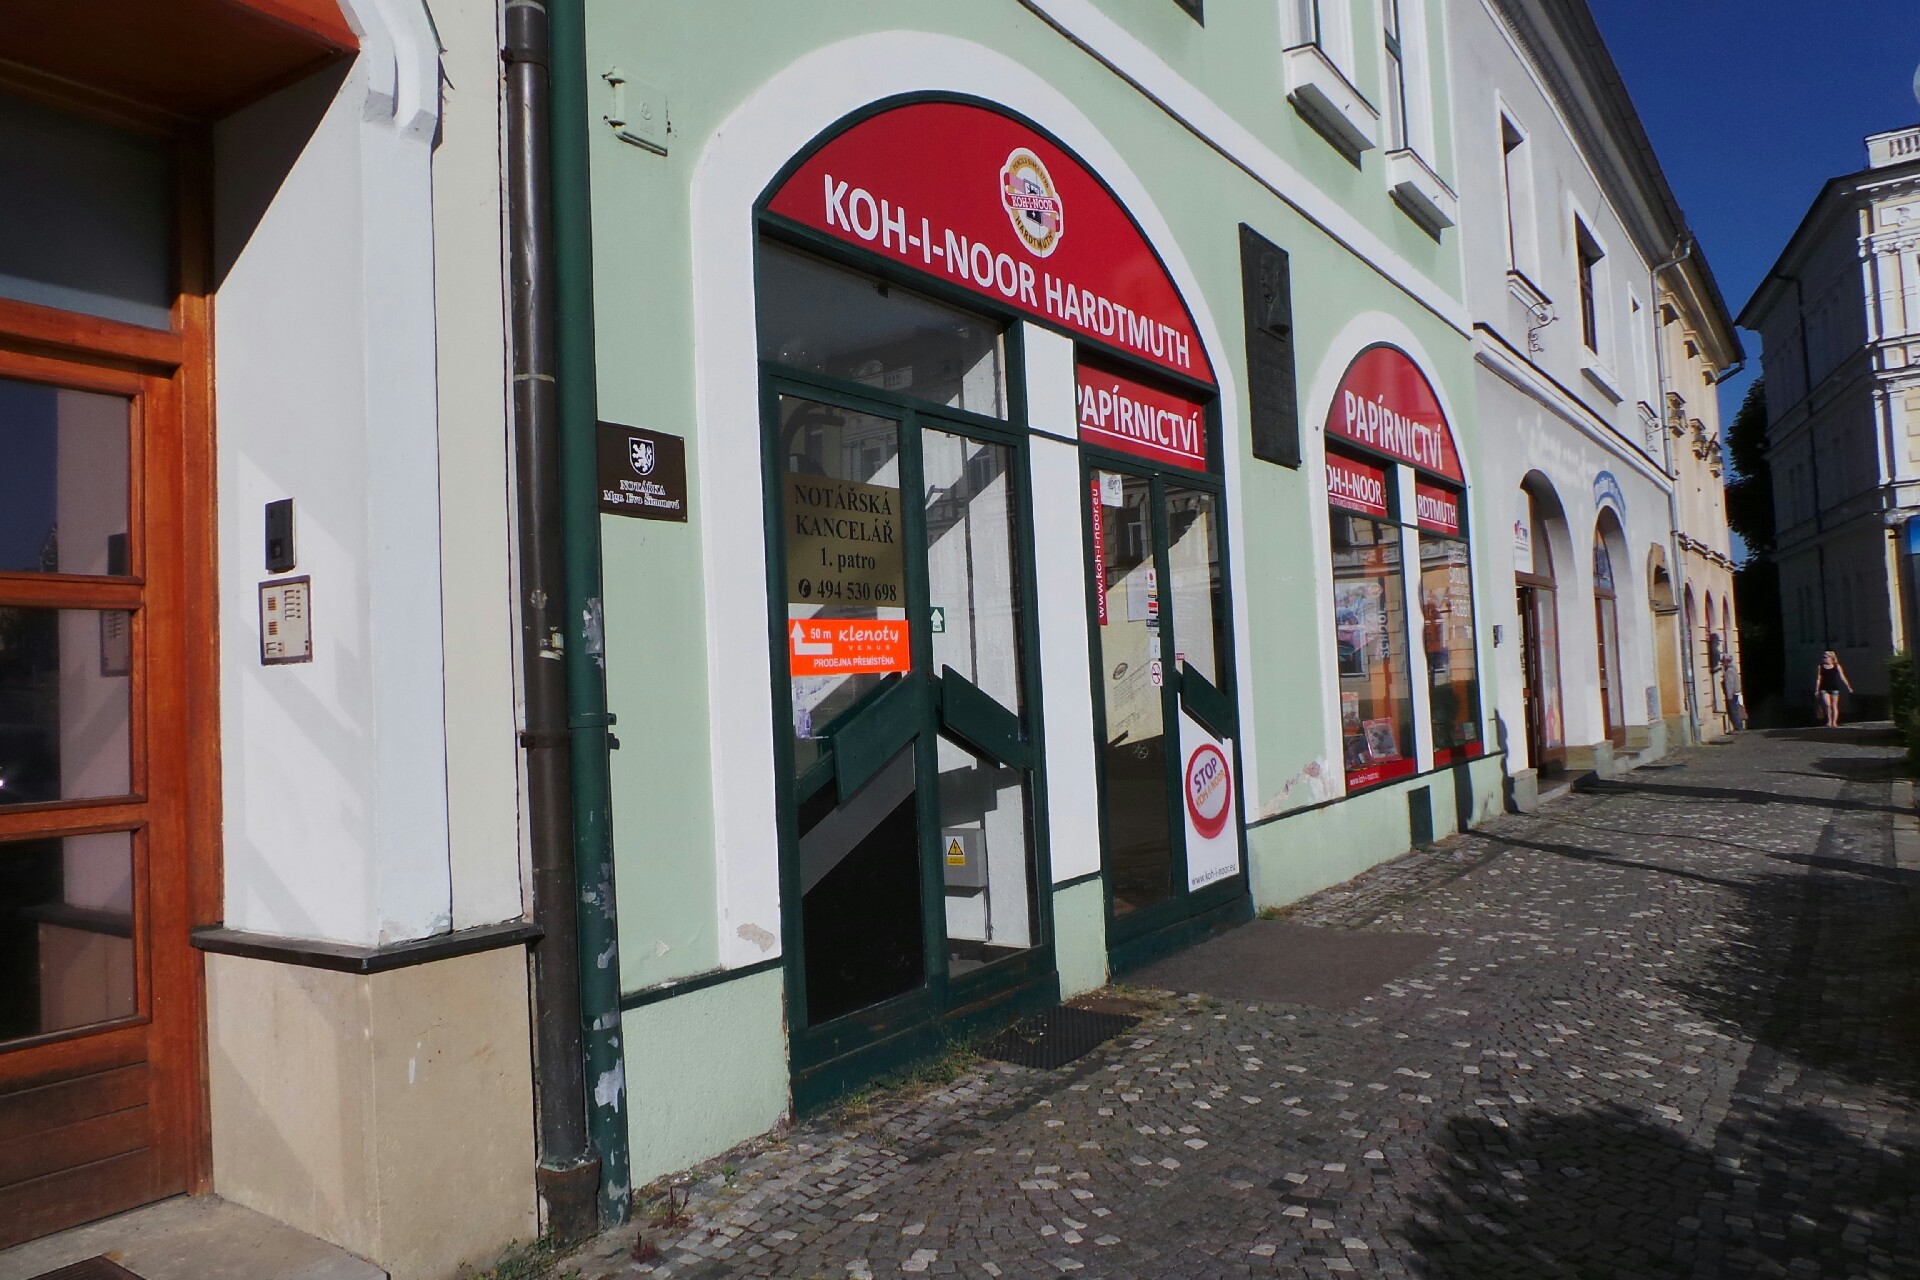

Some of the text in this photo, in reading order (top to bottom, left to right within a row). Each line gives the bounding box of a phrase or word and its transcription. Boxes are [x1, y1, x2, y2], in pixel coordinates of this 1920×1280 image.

[1012, 196, 1053, 211] KOH-I-NOOR
[1015, 216, 1053, 249] HARDTMUTH
[824, 173, 1190, 368] KOH-I-NOOR HARDTMUTH
[1344, 389, 1443, 471] PAPÍRNICTVÍ
[795, 485, 892, 516] NOTÁŘSKÁ
[795, 514, 894, 544] KANCELÁŘ
[821, 547, 876, 573] 1. patro
[1091, 487, 1105, 618] www.koh-i-noor.eu
[817, 579, 897, 602] 494 530 698
[810, 628, 821, 640] 50
[823, 630, 832, 639] m
[813, 655, 895, 668] PRODEJNA PŘEMÍSTĚNA
[1194, 757, 1217, 793] STOP
